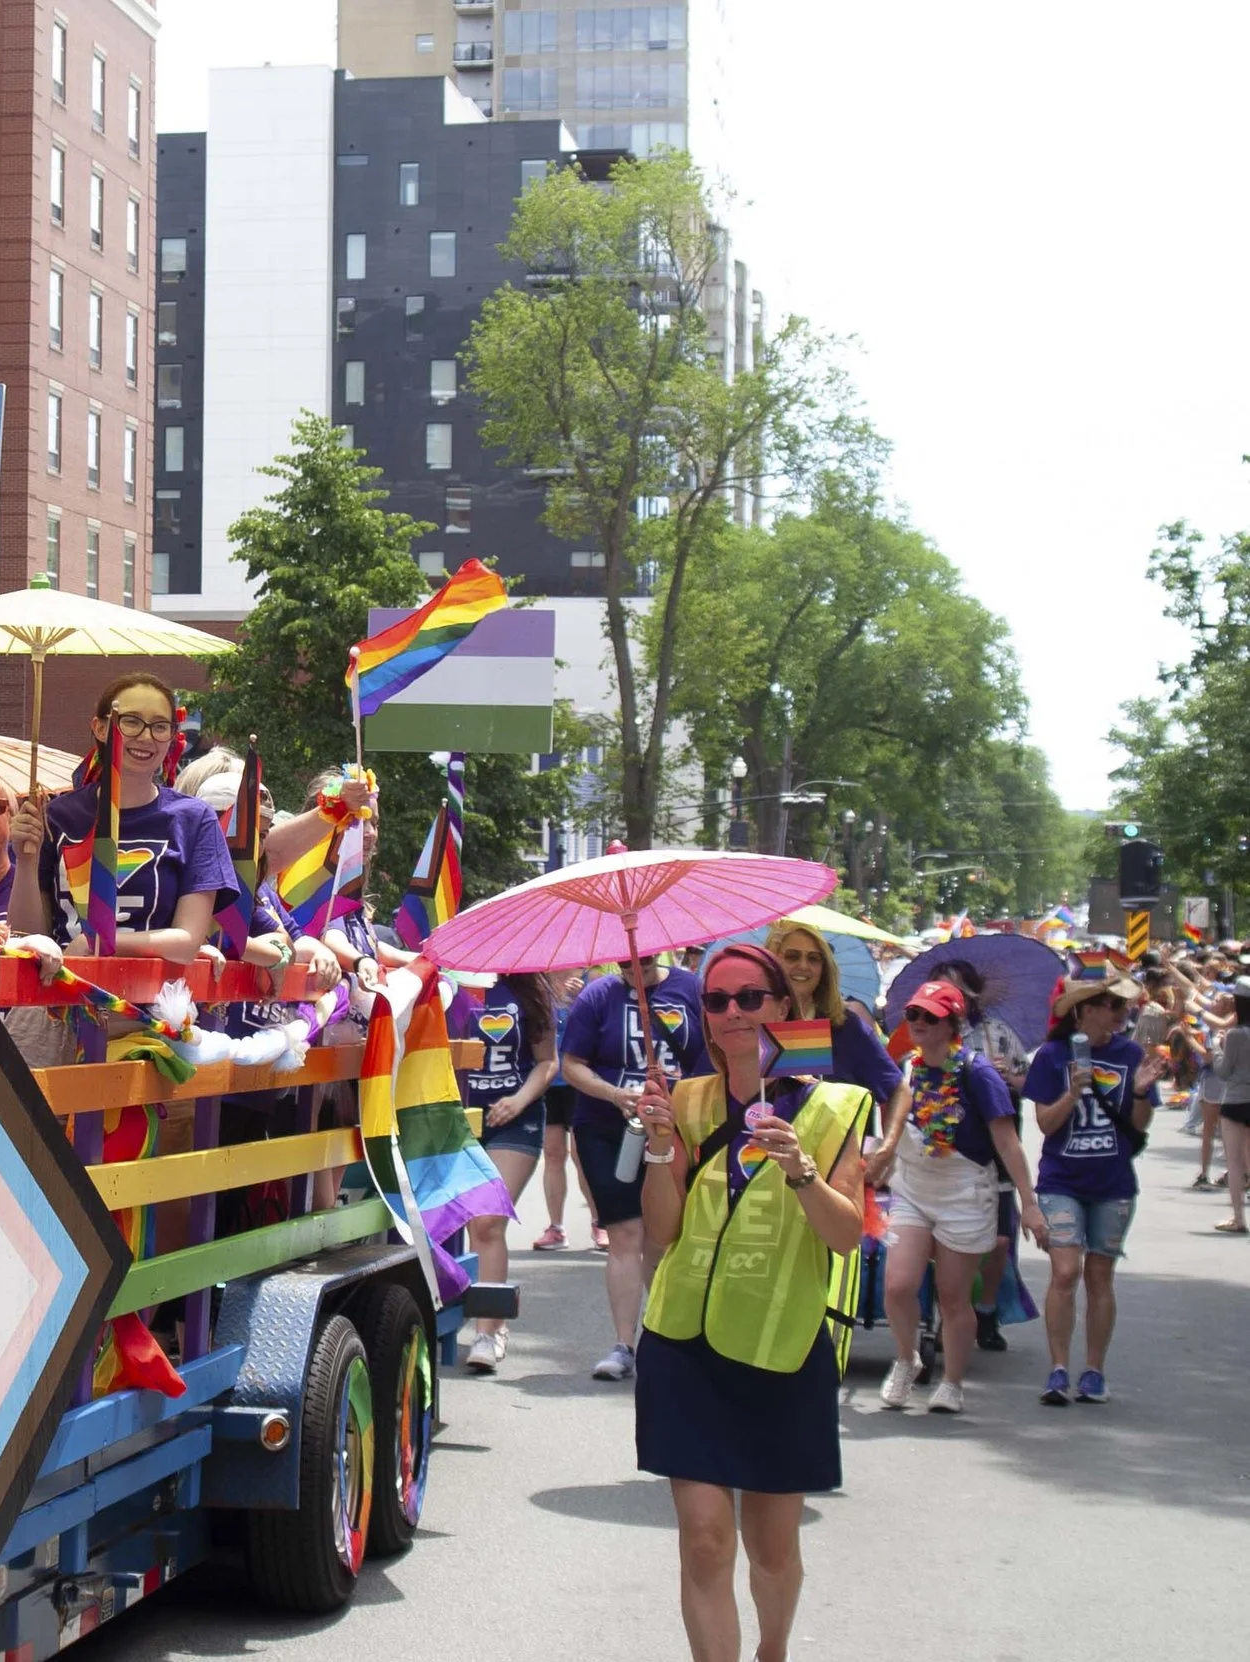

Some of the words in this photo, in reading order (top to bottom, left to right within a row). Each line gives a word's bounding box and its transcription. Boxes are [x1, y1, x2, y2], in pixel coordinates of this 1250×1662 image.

[630, 1011, 645, 1038] L
[1069, 1135, 1114, 1151] nscc
[691, 1248, 766, 1271] ncc
